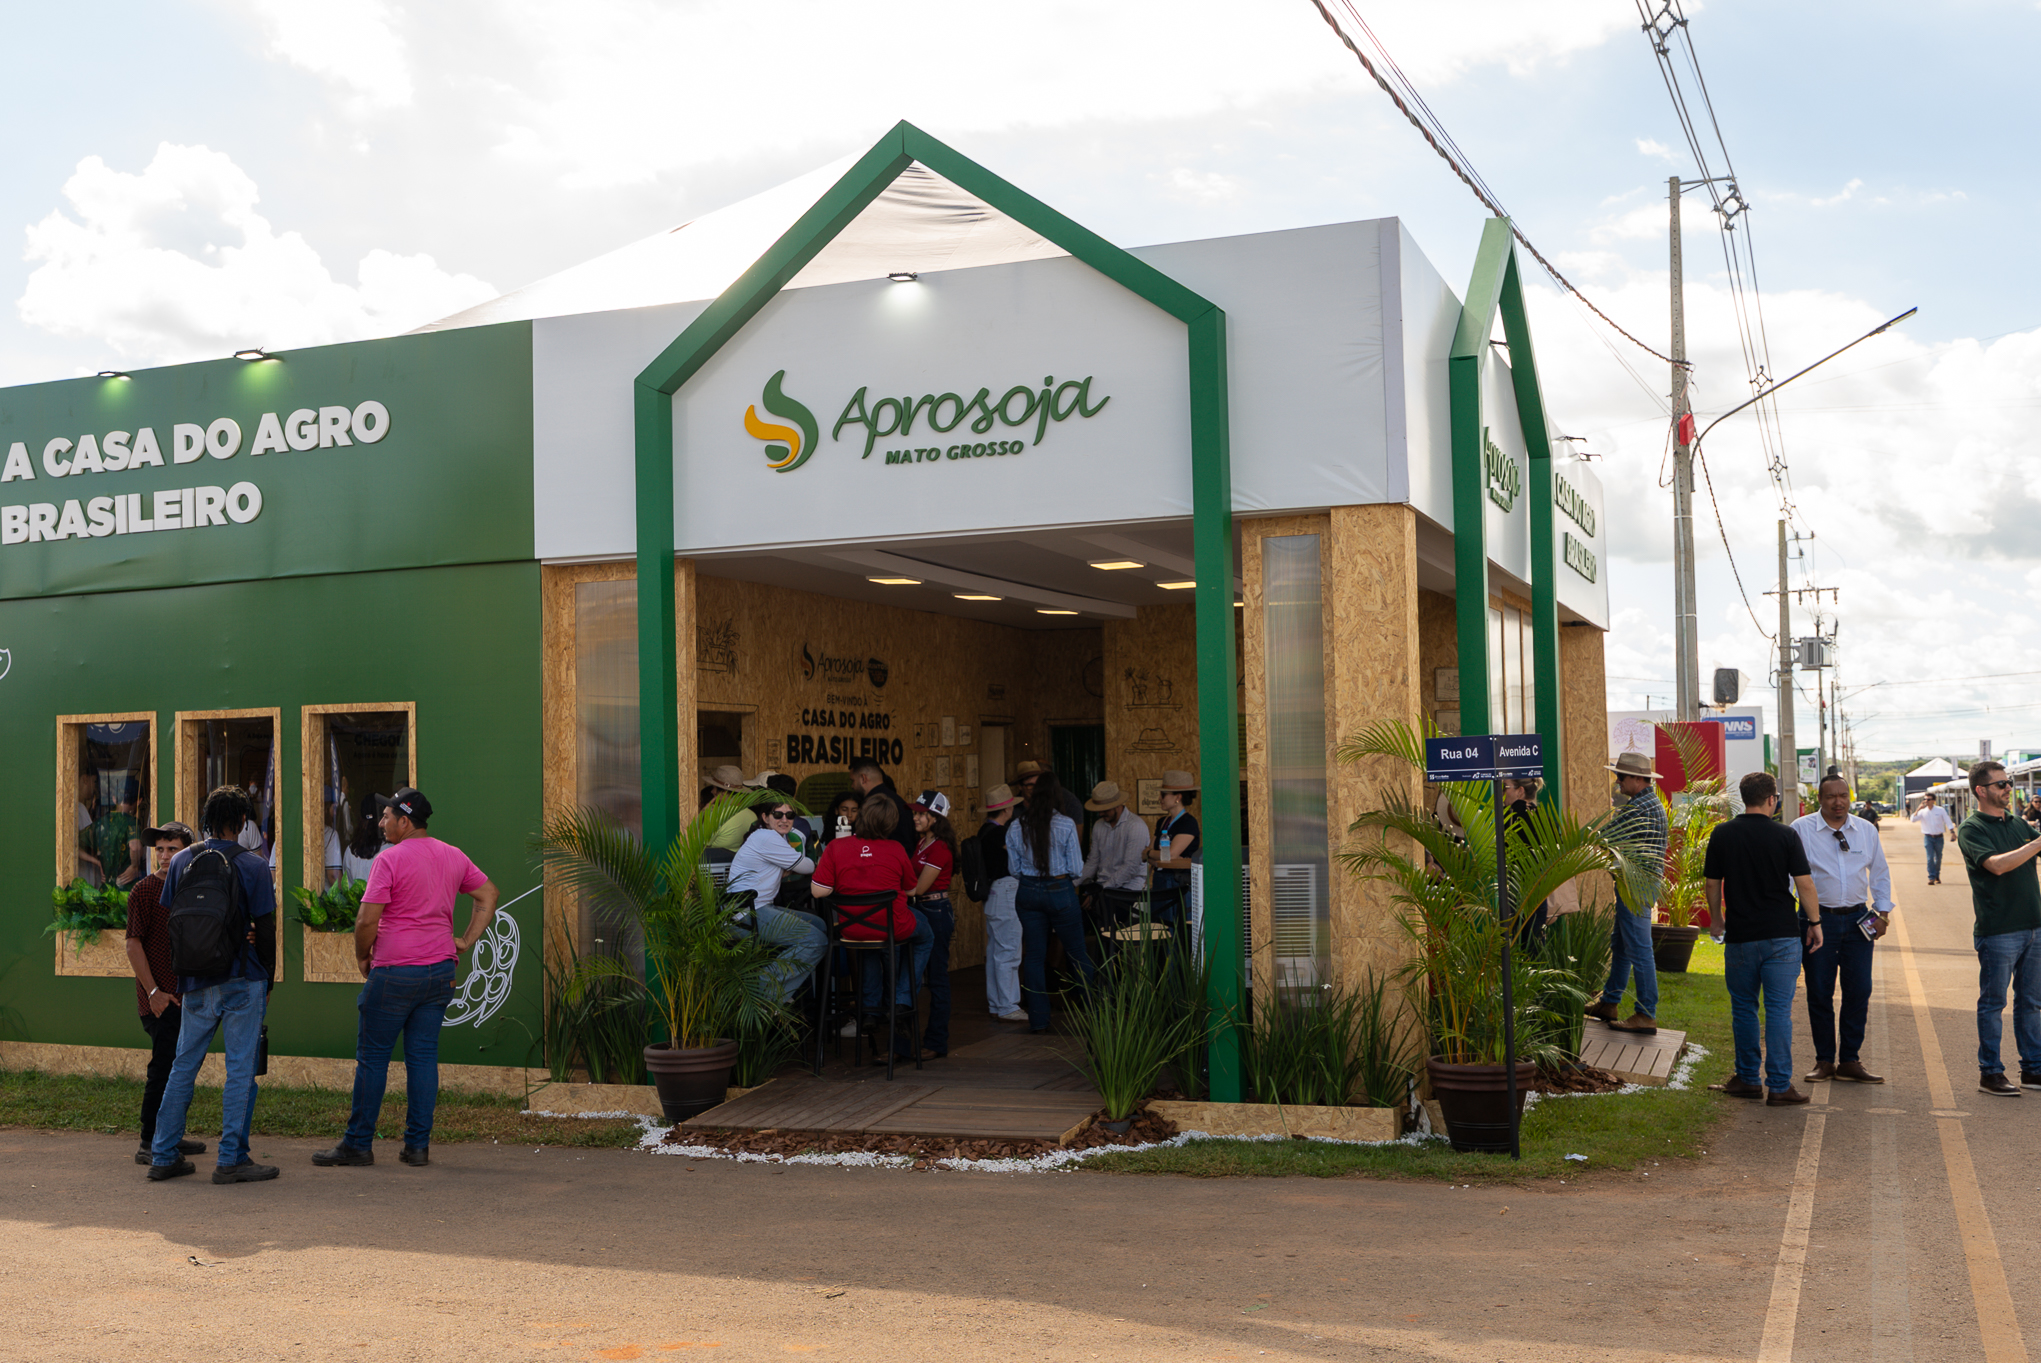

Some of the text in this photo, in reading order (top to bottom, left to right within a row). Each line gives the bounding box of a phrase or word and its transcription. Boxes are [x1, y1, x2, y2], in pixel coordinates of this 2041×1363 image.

[832, 375, 1111, 459] Aprosoja
[2, 400, 391, 482] A CASA DO AGRO
[885, 439, 1024, 465] MATO GROSSO
[1, 481, 263, 545] BRASILEIRO
[817, 652, 865, 680] Aprosoja
[827, 694, 862, 706] BEM-VINDO
[802, 708, 890, 730] CASA DO AGRO
[354, 734, 405, 747] CHEGOU
[787, 734, 903, 765] BRASILEIRO
[1441, 747, 1479, 760] Rua 04
[1499, 744, 1539, 757] Avenida C
